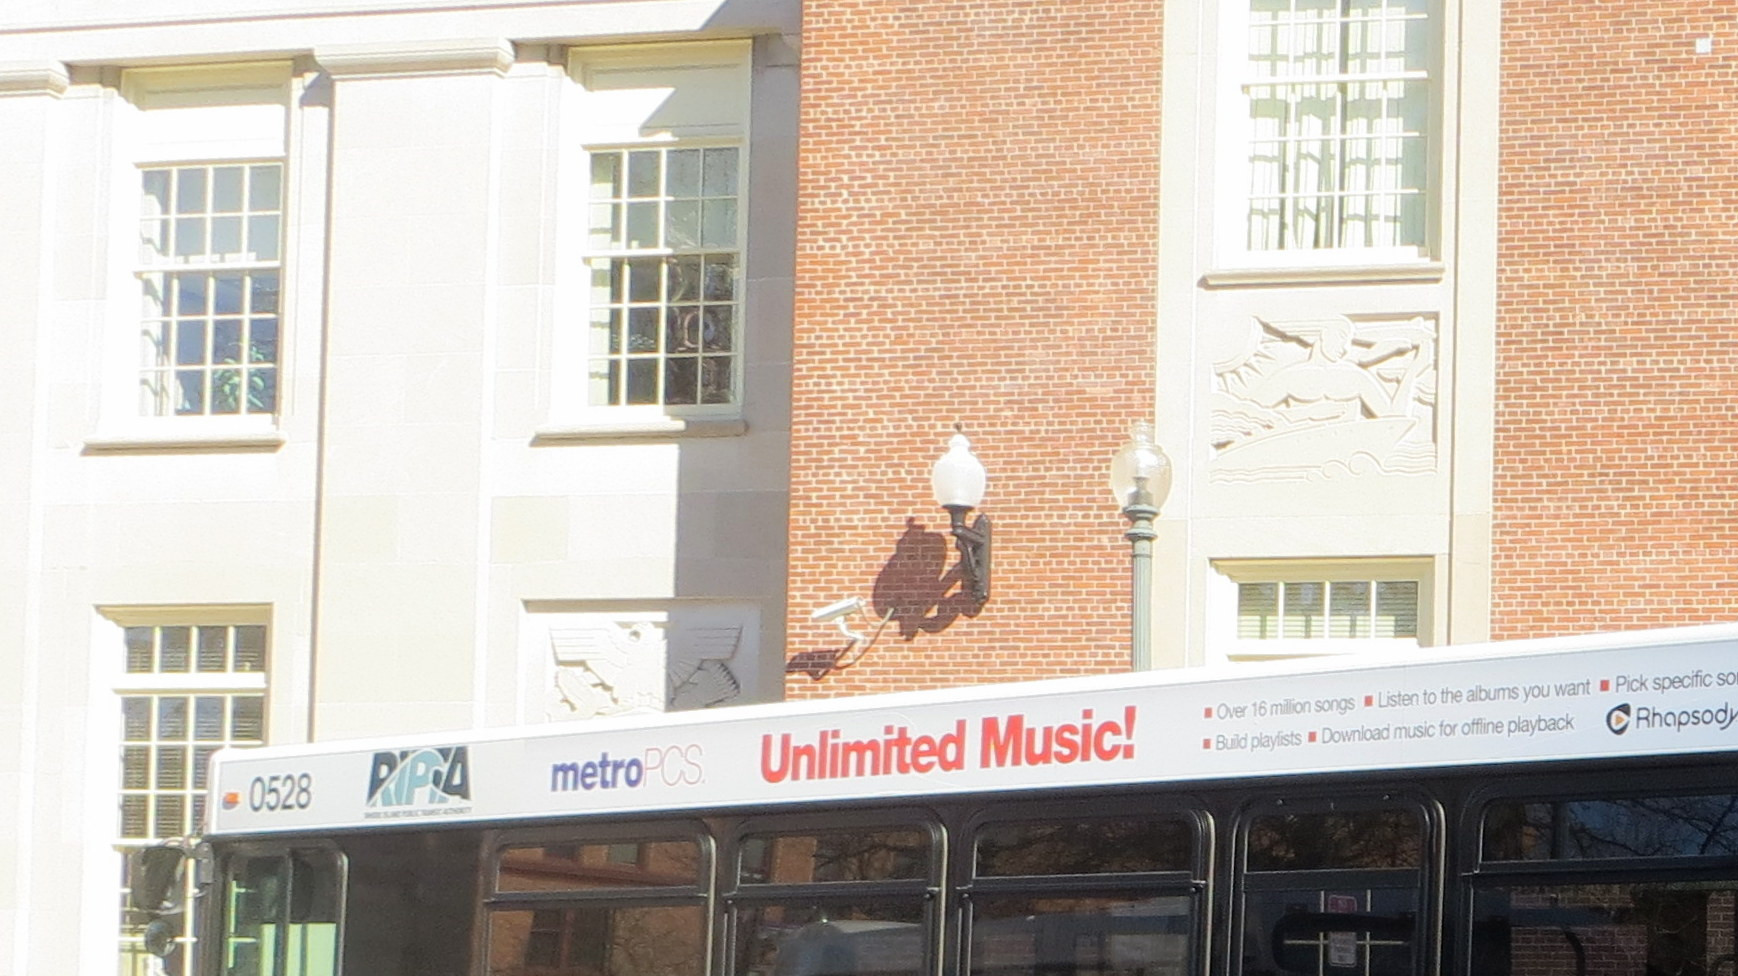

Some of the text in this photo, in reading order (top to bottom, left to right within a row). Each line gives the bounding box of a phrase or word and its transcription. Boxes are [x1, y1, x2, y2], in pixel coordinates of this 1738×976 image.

[1378, 679, 1591, 708] Listen to the albums you want
[1616, 674, 1648, 693] Pick
[1652, 669, 1713, 691] specific
[1217, 696, 1355, 720] Over 16 million songs
[1216, 730, 1302, 752] Build playlists
[1322, 713, 1575, 744] Download music for offline playback
[760, 705, 1137, 784] Unlimited Music!
[250, 773, 312, 812] 0528
